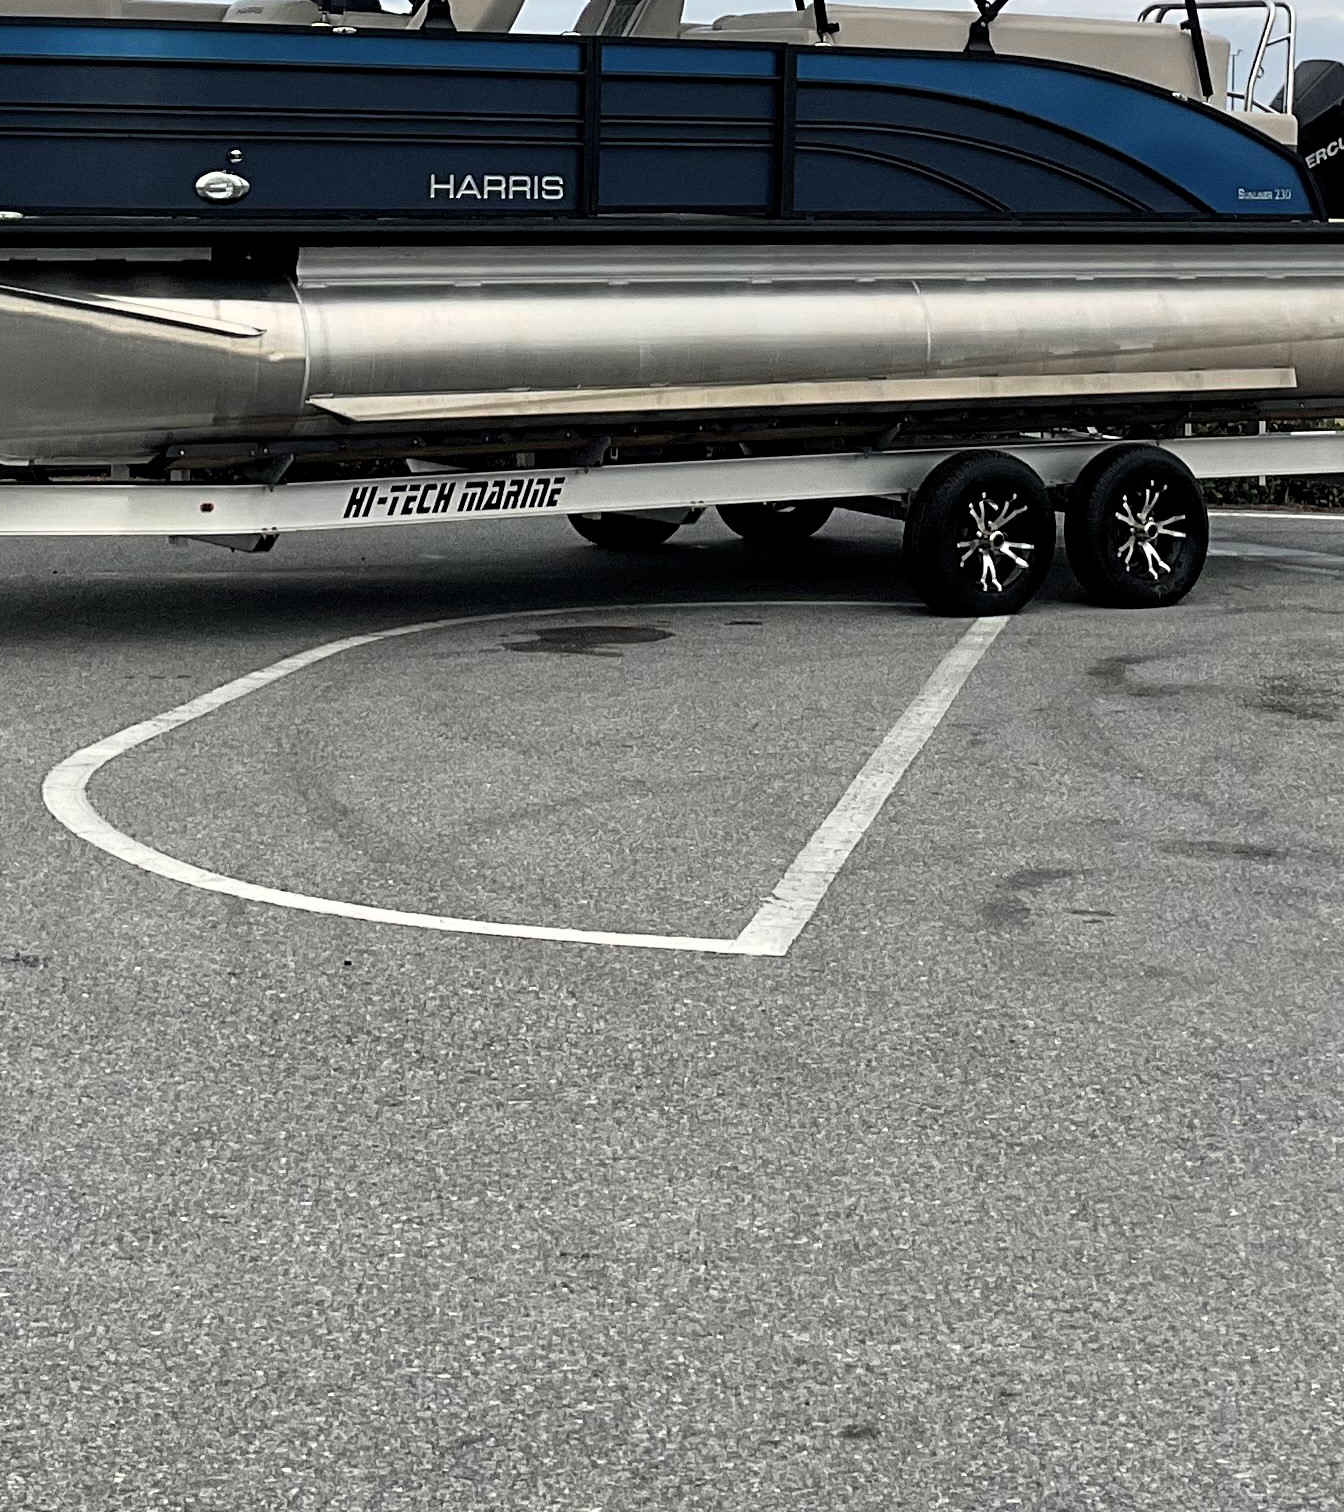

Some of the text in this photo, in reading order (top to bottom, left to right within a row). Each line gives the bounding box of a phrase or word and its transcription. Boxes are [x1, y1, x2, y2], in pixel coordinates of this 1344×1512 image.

[429, 173, 565, 200] HARRIS
[1274, 188, 1292, 200] 230
[343, 476, 566, 519] HI-TECH MARINE
